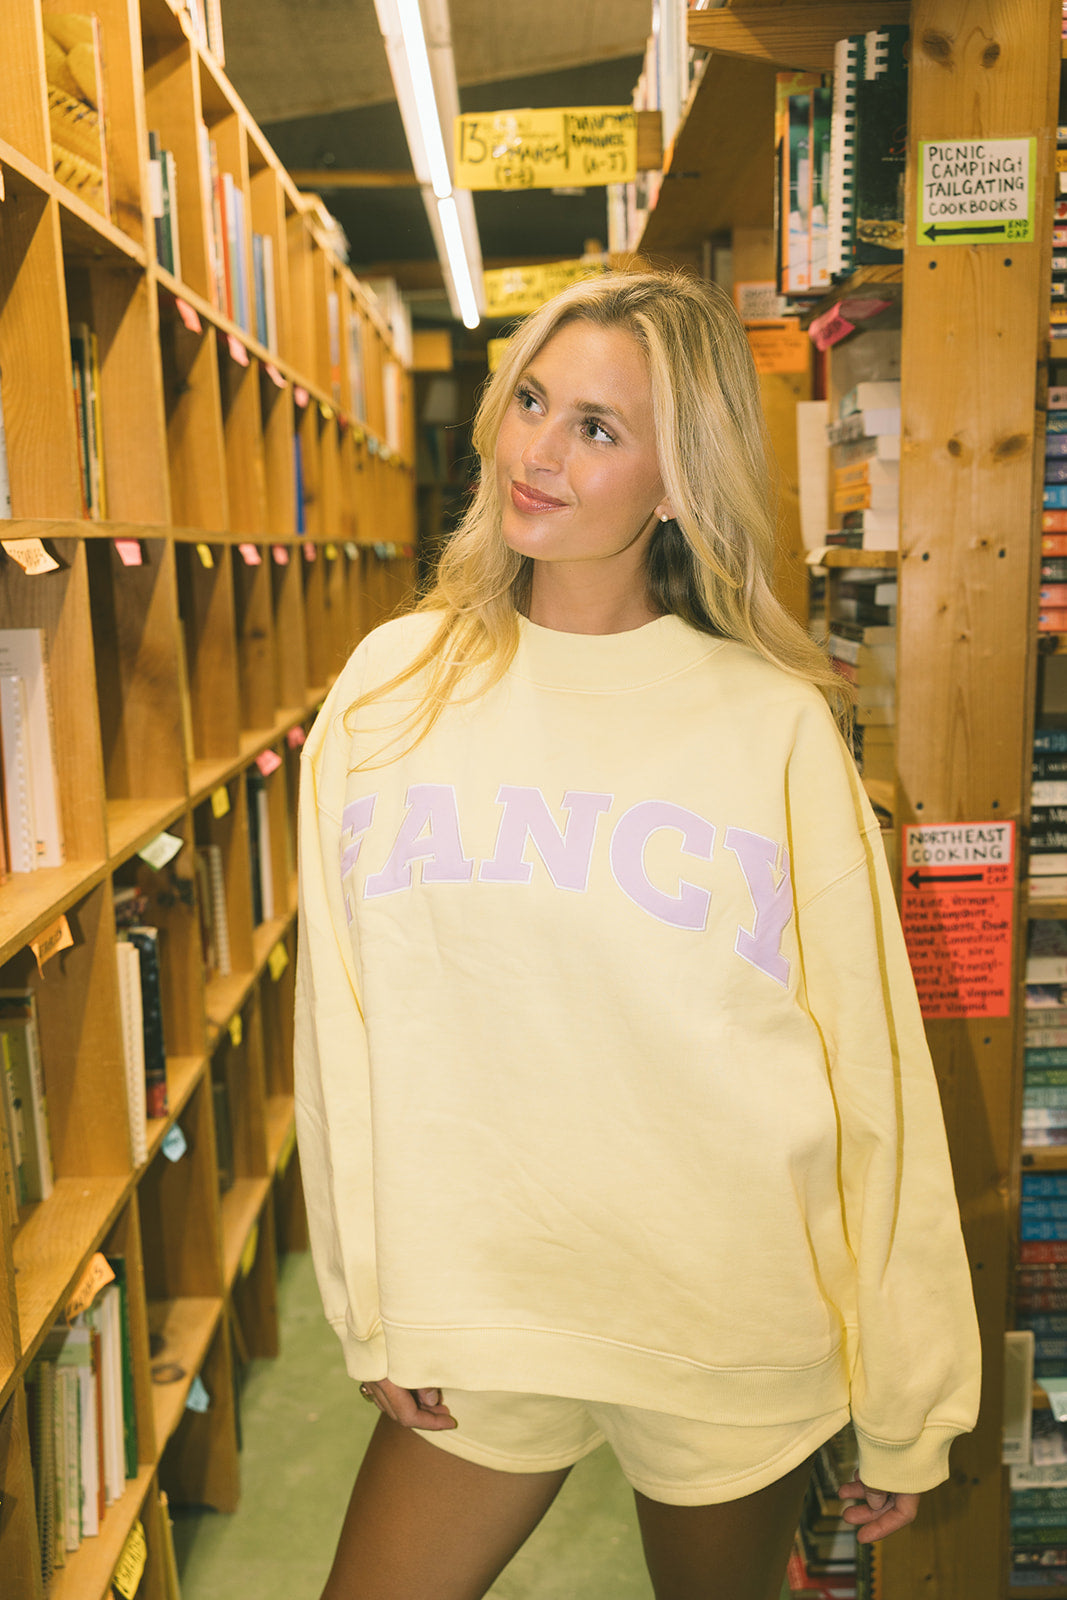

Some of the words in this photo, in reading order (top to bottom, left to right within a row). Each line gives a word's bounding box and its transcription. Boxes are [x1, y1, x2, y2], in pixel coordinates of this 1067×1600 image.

[460, 121, 487, 163] 13
[931, 157, 1014, 179] CAMPING
[925, 176, 1025, 198] TAILGATING
[928, 198, 1018, 216] COOKBOOKS
[1007, 219, 1029, 229] END
[1006, 229, 1029, 239] CAP
[909, 827, 1006, 846] NORTHEAST
[911, 845, 1003, 863] COOKING
